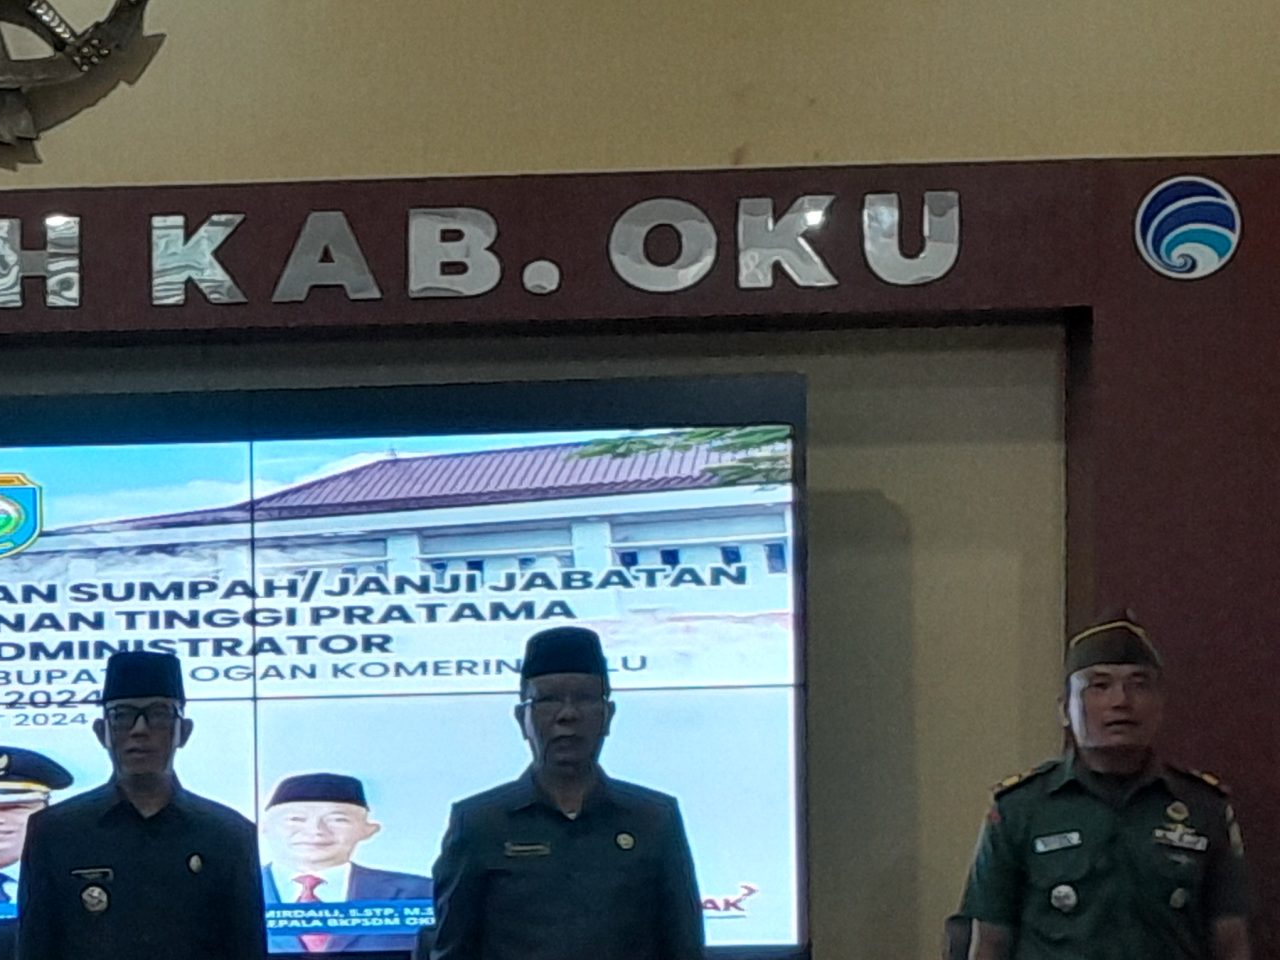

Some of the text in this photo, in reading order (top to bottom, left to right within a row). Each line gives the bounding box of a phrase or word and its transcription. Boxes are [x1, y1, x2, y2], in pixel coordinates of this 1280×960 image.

[150, 208, 562, 306] KAB.
[608, 190, 962, 294] OKU
[69, 570, 479, 603] SUMPAH/JANJI
[489, 565, 748, 593] JABATAN
[115, 606, 297, 632] TINGGI
[309, 601, 578, 626] PRATAMA
[189, 663, 317, 682] OGAN
[331, 657, 523, 680] KOMERIN
[4, 688, 103, 709] 2024
[15, 712, 89, 727] 2024
